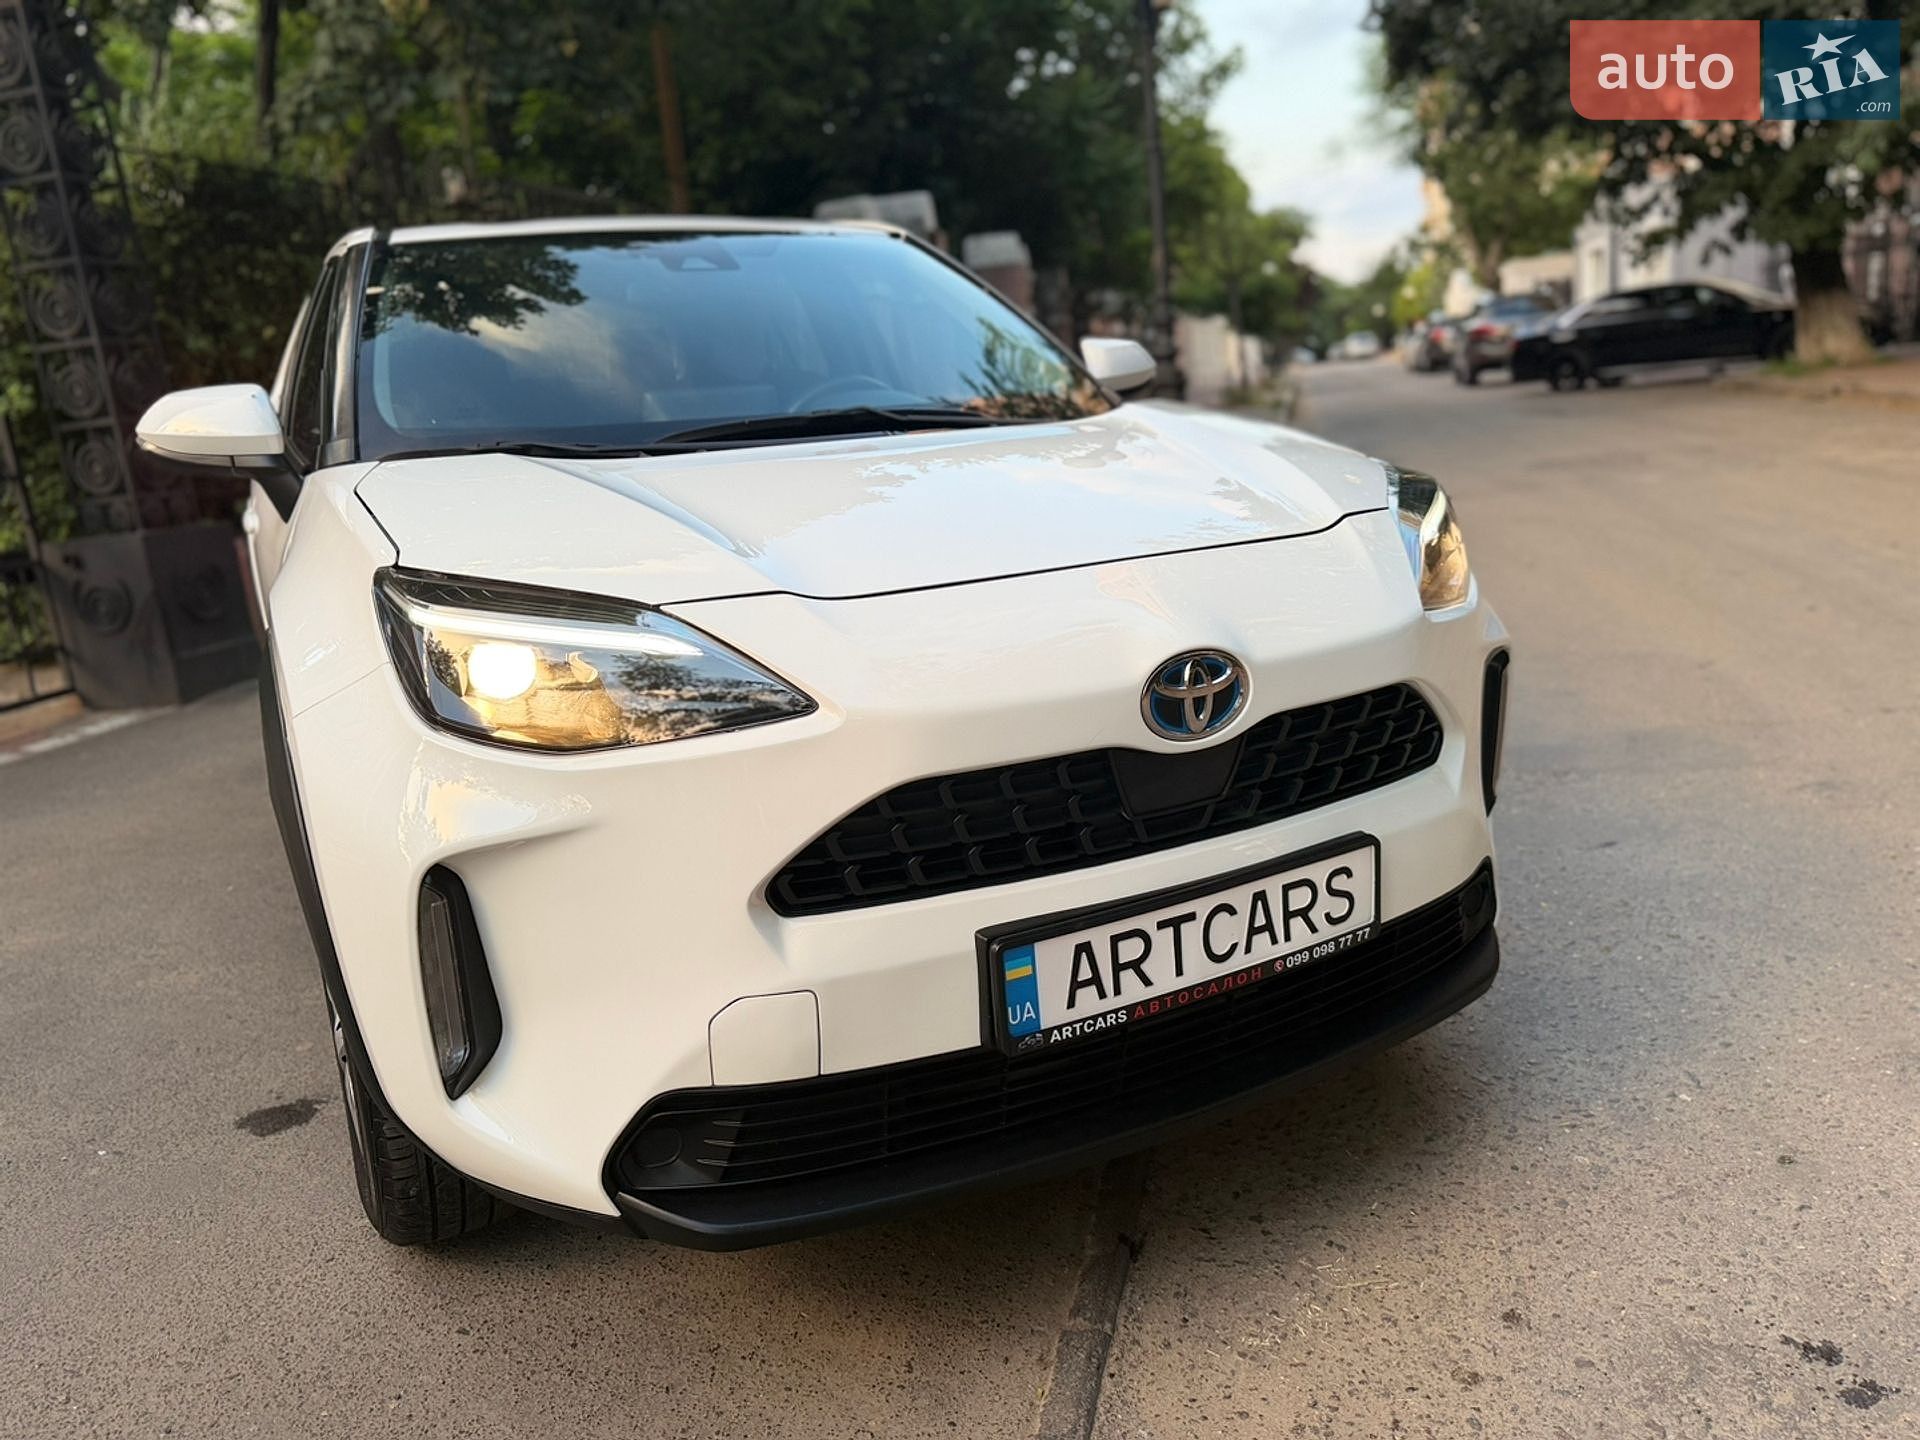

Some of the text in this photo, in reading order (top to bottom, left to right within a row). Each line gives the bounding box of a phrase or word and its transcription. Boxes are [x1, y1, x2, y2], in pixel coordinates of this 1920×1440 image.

[1049, 927, 1371, 1044] ARTCARS АВТОСАЛОН 099 098 77 77
[1066, 865, 1355, 1010] ARTCARS
[1008, 1001, 1036, 1025] UA
